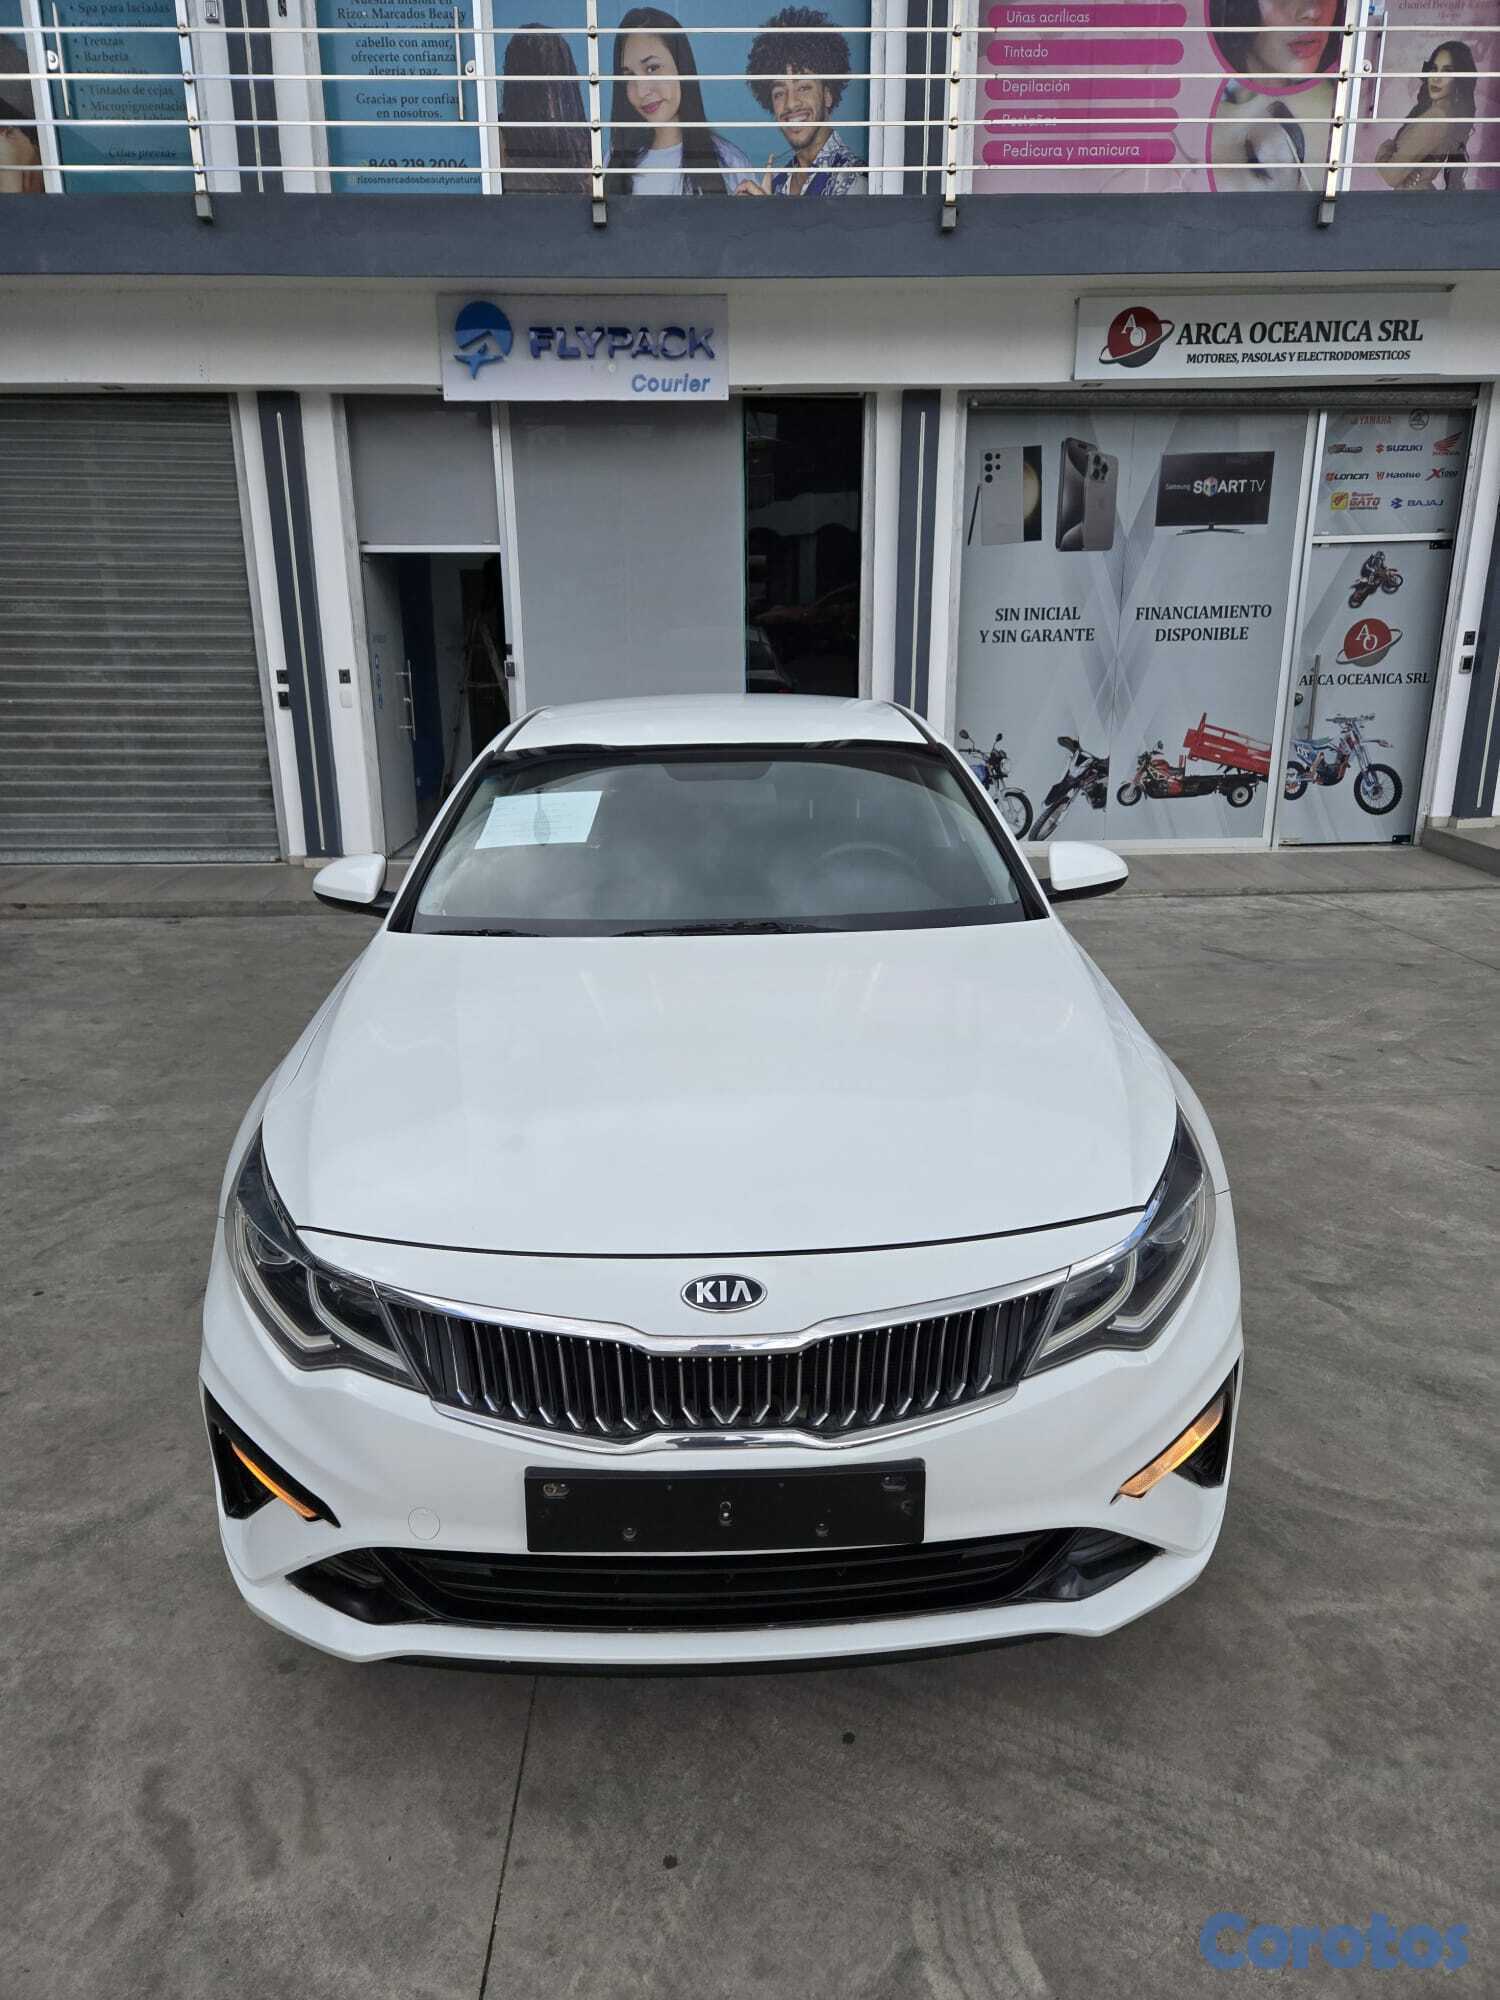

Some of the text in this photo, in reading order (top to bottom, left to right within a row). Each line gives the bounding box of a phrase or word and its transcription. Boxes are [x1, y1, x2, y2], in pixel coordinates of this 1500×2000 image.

[372, 8, 425, 19] Marcados
[1006, 11, 1036, 23] Uñas
[356, 36, 396, 48] cabello
[399, 39, 418, 48] con
[351, 50, 399, 62] ofrecerte
[1004, 43, 1048, 58] Tintado
[1002, 79, 1070, 96] Depilación
[90, 100, 187, 113] Micropigmentació
[356, 92, 398, 105] Gracias
[400, 95, 419, 107] por
[376, 108, 442, 119] en nosotros.
[1003, 143, 1141, 161] Pedicura y manicura
[1176, 319, 1424, 345] ARCA OCEANICA SRL
[529, 326, 715, 360] FLYPACK
[1186, 350, 1411, 364] MOTORES, PASOLAS Y ELECTRODOMESTICOS
[631, 373, 711, 393] Courier
[1249, 479, 1265, 493] TV
[994, 606, 1081, 622] SIN INICIAL
[1136, 604, 1272, 621] FINANCIAMIENTO
[979, 627, 1095, 643] Y SIN GARANTE
[1155, 626, 1250, 642] DISPONIBLE
[1337, 673, 1402, 686] OCEANICA
[1405, 672, 1431, 684] SRL
[696, 1280, 753, 1304] KIA
